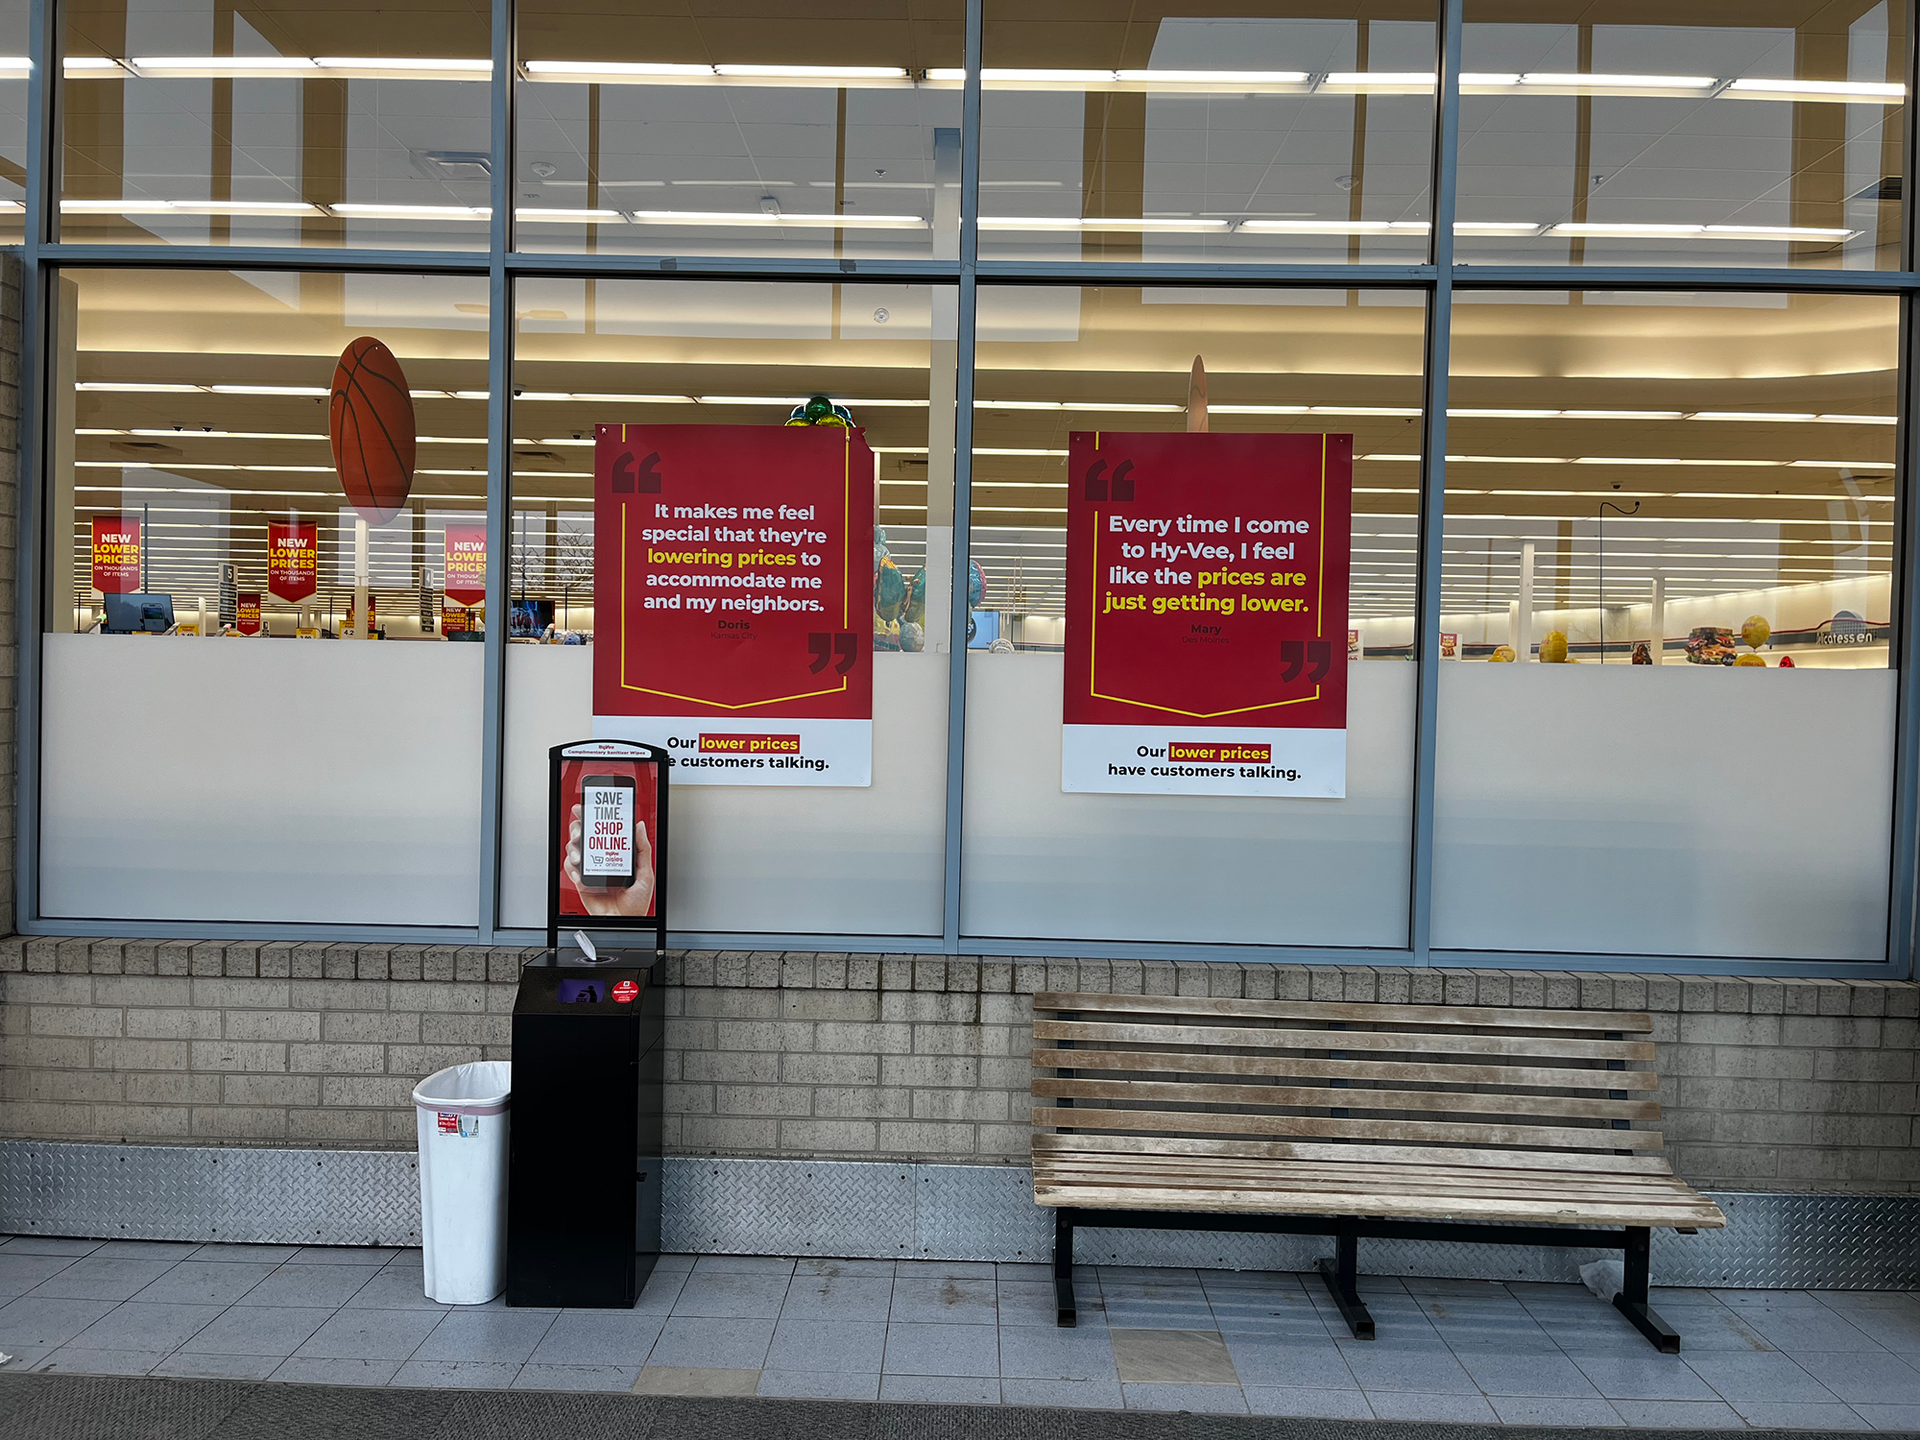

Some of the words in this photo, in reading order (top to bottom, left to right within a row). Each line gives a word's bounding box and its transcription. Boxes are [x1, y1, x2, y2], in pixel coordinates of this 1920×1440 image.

[655, 503, 669, 519] It
[674, 503, 738, 519] makes
[742, 506, 774, 520] me
[778, 505, 815, 520] feel
[1109, 515, 1171, 537] Every
[1176, 514, 1229, 533] time
[1234, 516, 1240, 533] I
[1246, 519, 1309, 534] come
[101, 533, 131, 543] NEW
[277, 538, 308, 547] NEW
[642, 525, 709, 544] special
[714, 526, 754, 542] that
[759, 527, 827, 546] they're
[94, 544, 139, 554] LOWER
[270, 548, 315, 558] LOWER
[454, 541, 484, 551] NEW
[1121, 542, 1145, 558] to
[1151, 542, 1235, 563] Hy-Vee,
[1241, 542, 1247, 559] I
[1252, 542, 1294, 560] feel
[94, 554, 138, 564] PRICES
[271, 558, 315, 569] PRICES
[446, 552, 486, 561] LOWE
[648, 548, 732, 568] lowering
[738, 549, 796, 568] prices
[801, 552, 821, 566] to
[227, 568, 233, 579] 5
[426, 572, 430, 583] 4
[646, 572, 786, 588] accommodate
[790, 576, 822, 589] me
[1109, 565, 1149, 584] like
[1154, 567, 1192, 584] the
[1198, 566, 1265, 589] prices
[1270, 571, 1306, 586] are
[643, 594, 681, 609] and
[686, 598, 716, 613] my
[721, 594, 825, 614] neighbors.
[1102, 591, 1146, 614] just
[1152, 592, 1235, 615] getting
[1241, 594, 1309, 612] lower.
[718, 619, 750, 629] Doris
[1191, 624, 1222, 636] Mary
[710, 631, 740, 639] Kansas
[741, 632, 758, 640] City
[667, 736, 696, 749] Our
[701, 736, 745, 749] lower
[750, 737, 798, 752] prices
[1136, 745, 1166, 757] Our
[1171, 745, 1216, 758] lower
[1220, 746, 1269, 761] prices
[681, 757, 764, 768] customers
[769, 756, 830, 771] talking.
[1108, 763, 1146, 775] have
[1150, 766, 1235, 778] customers
[1239, 766, 1302, 781] talking.
[595, 791, 623, 806] SAVE
[594, 806, 623, 821] TIME.
[594, 821, 623, 836] SHOP
[588, 836, 631, 851] ONLINE.
